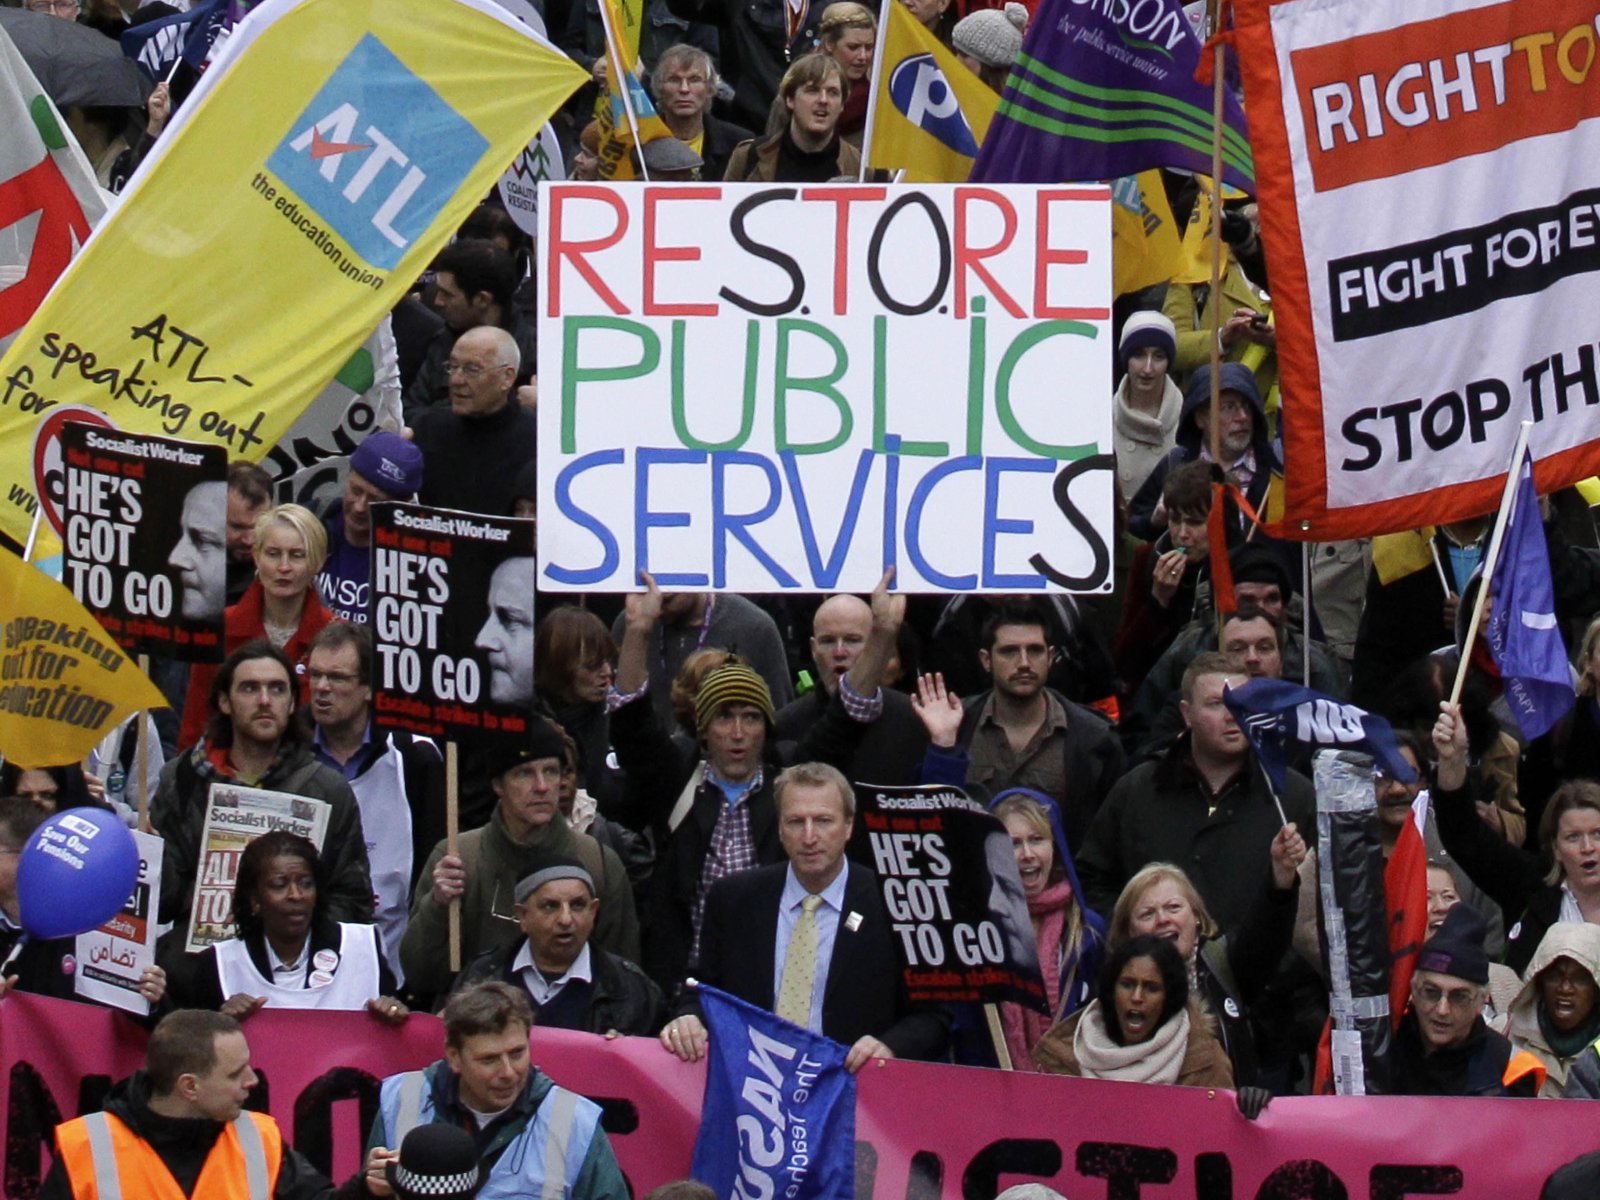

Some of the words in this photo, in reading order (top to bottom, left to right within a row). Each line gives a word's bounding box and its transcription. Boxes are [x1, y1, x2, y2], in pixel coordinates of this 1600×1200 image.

[1311, 43, 1511, 151] RIGHT
[1512, 24, 1596, 92] TO
[289, 103, 427, 248] ATL
[251, 173, 276, 201] the
[275, 197, 341, 265] education
[339, 255, 384, 291] union
[1338, 244, 1473, 314] FIGHT
[1486, 221, 1561, 278] FOR
[2, 365, 58, 416] for
[40, 332, 192, 435] speaking
[199, 410, 266, 455] out
[1341, 377, 1512, 471] STOP
[67, 468, 143, 522] HE'S
[67, 514, 136, 569] GOT
[393, 509, 457, 536] Socialist
[455, 519, 510, 542] Worker
[67, 560, 112, 609] TO
[122, 570, 174, 618] GO
[375, 547, 450, 604] HE'S
[375, 596, 444, 650] GOT
[33, 645, 78, 681] for
[376, 643, 422, 694] TO
[431, 654, 481, 704] GO
[210, 808, 265, 829] Socialist
[876, 793, 941, 811] Socialist
[36, 839, 85, 871] Pensions
[40, 826, 67, 845] Save
[69, 835, 90, 855] Our
[869, 832, 952, 877] HE'S
[883, 878, 952, 921] GOT
[892, 923, 945, 966] TO
[952, 920, 1005, 966] GO
